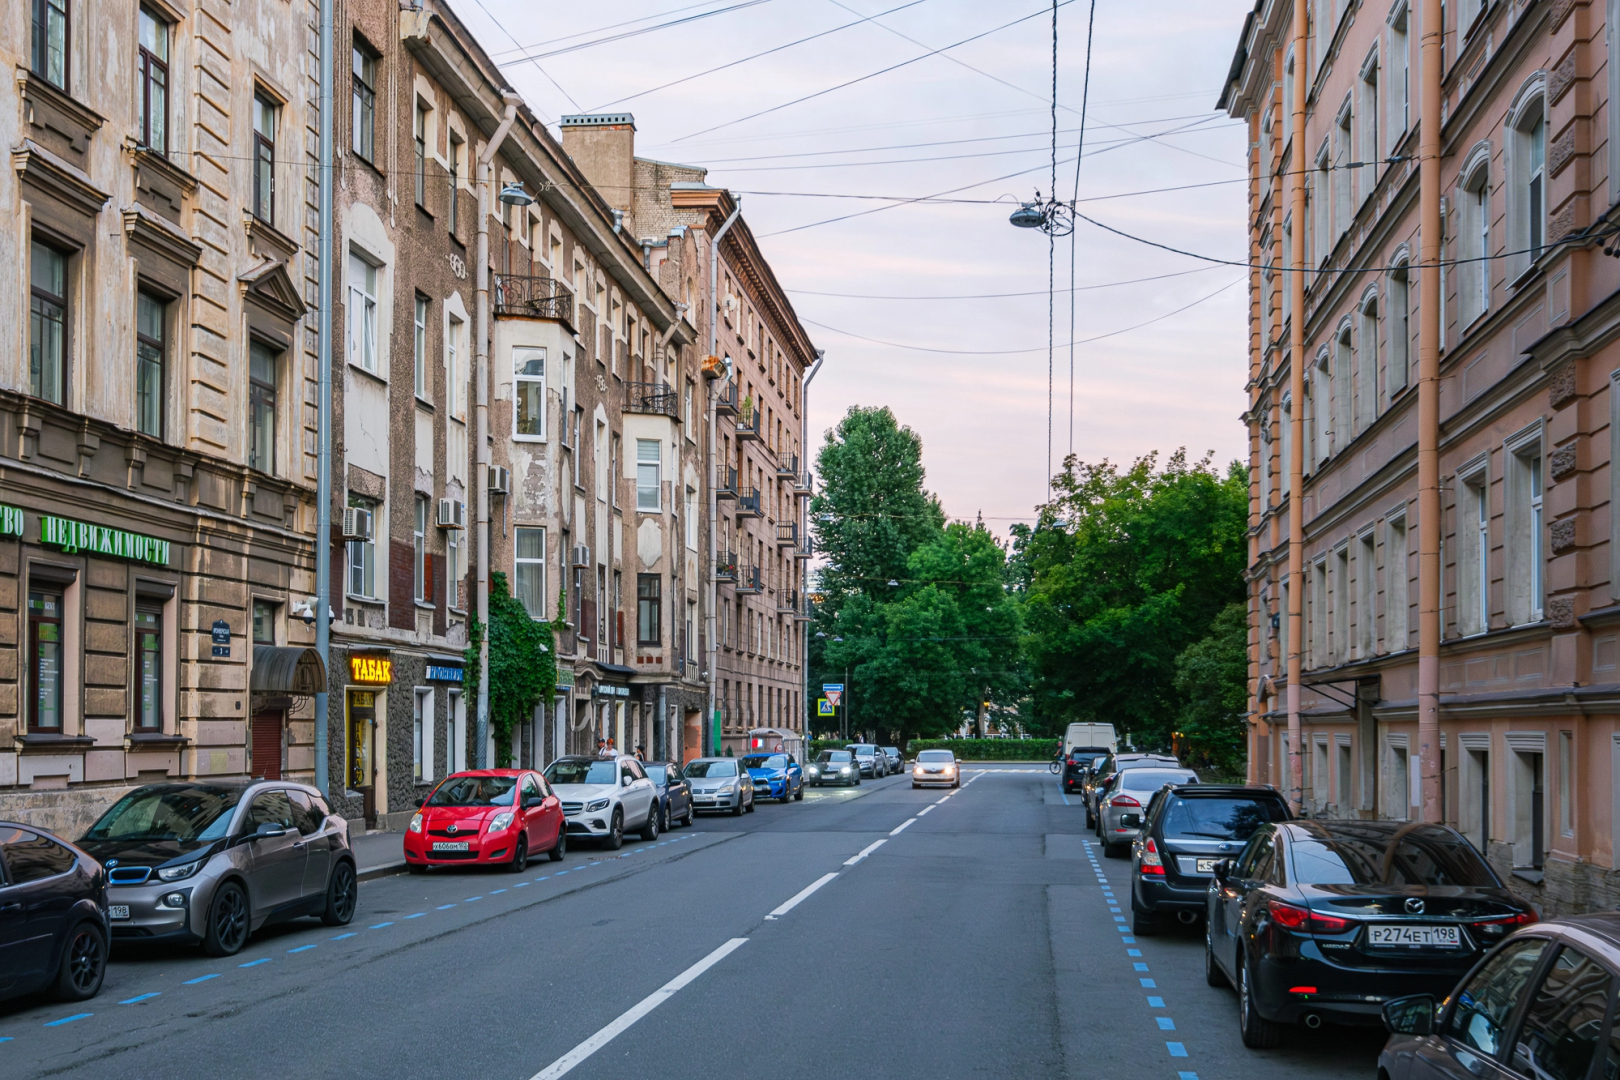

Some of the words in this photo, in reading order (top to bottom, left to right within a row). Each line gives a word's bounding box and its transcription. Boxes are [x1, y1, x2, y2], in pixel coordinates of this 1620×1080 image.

[0, 505, 24, 537] ВО
[45, 515, 171, 565] НЕДВИЖИМОСТИ
[352, 657, 391, 682] ТАБАК
[112, 906, 126, 915] 198
[1373, 927, 1431, 943] Р274ЕТ
[1433, 928, 1456, 940] 198
